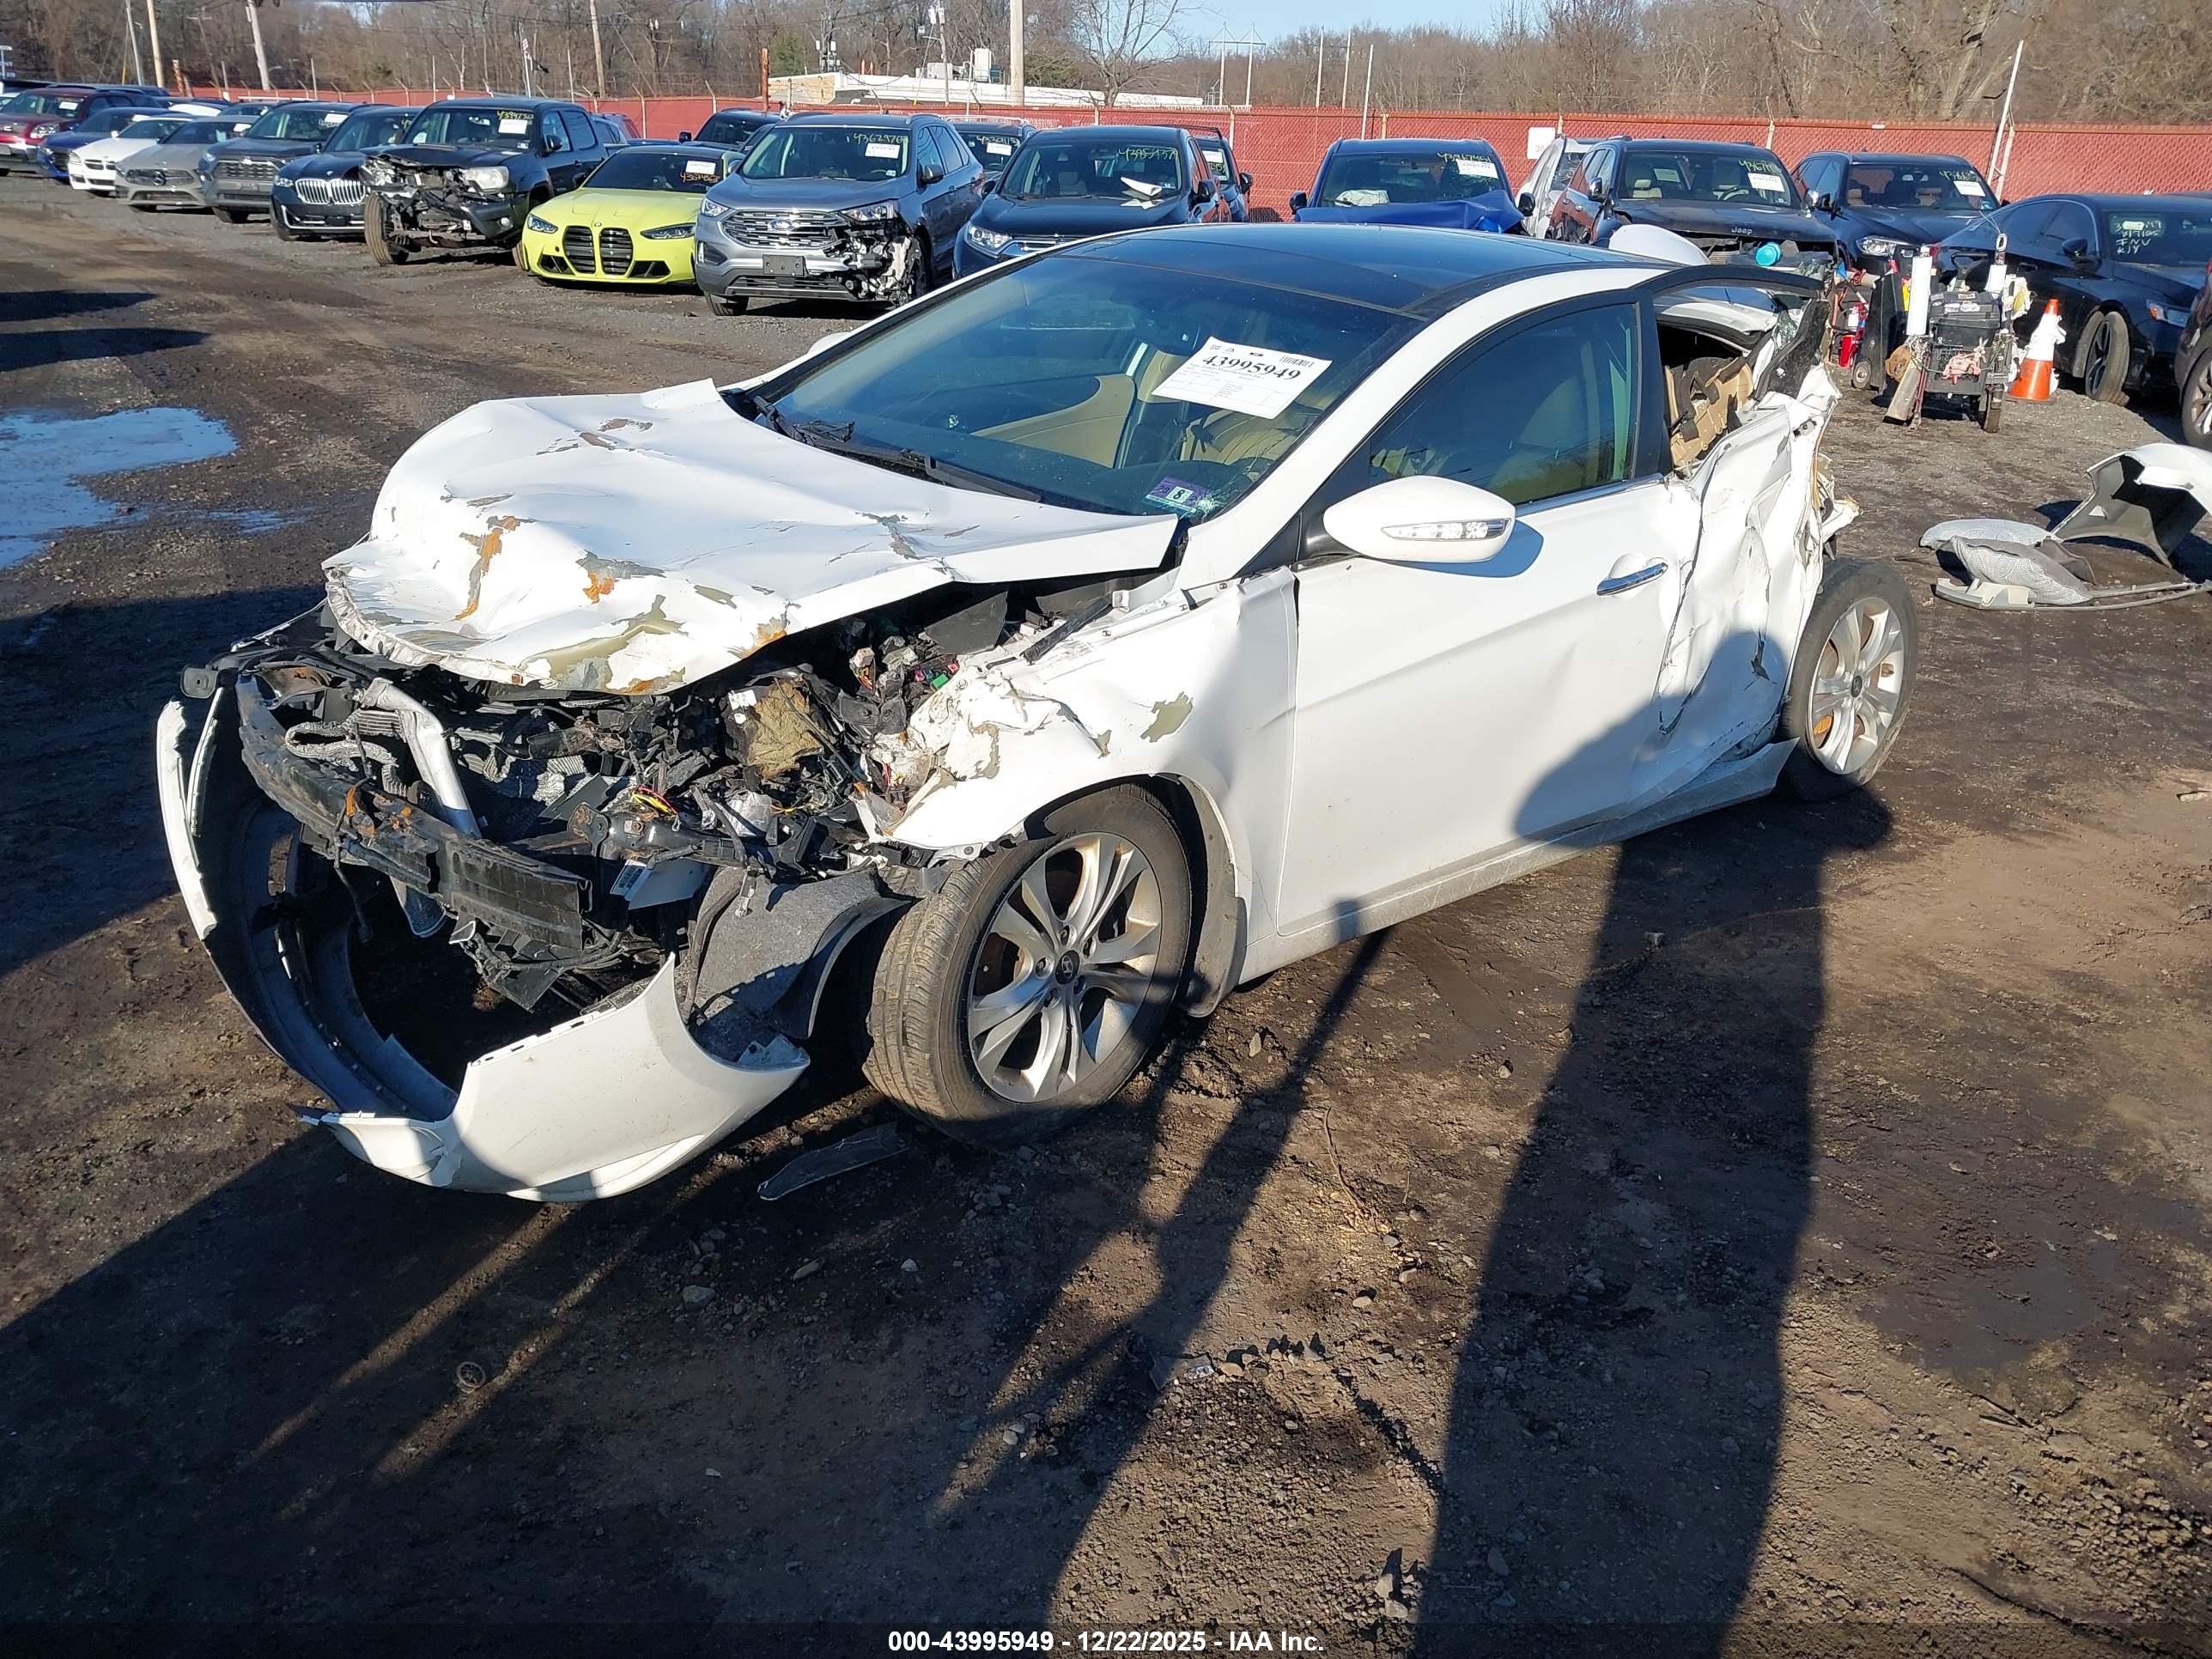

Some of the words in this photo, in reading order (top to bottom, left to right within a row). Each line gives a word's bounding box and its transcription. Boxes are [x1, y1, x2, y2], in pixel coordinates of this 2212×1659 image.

[1731, 227, 1753, 235] Jeep
[1203, 355, 1301, 380] 43995949
[1173, 489, 1185, 500] 8
